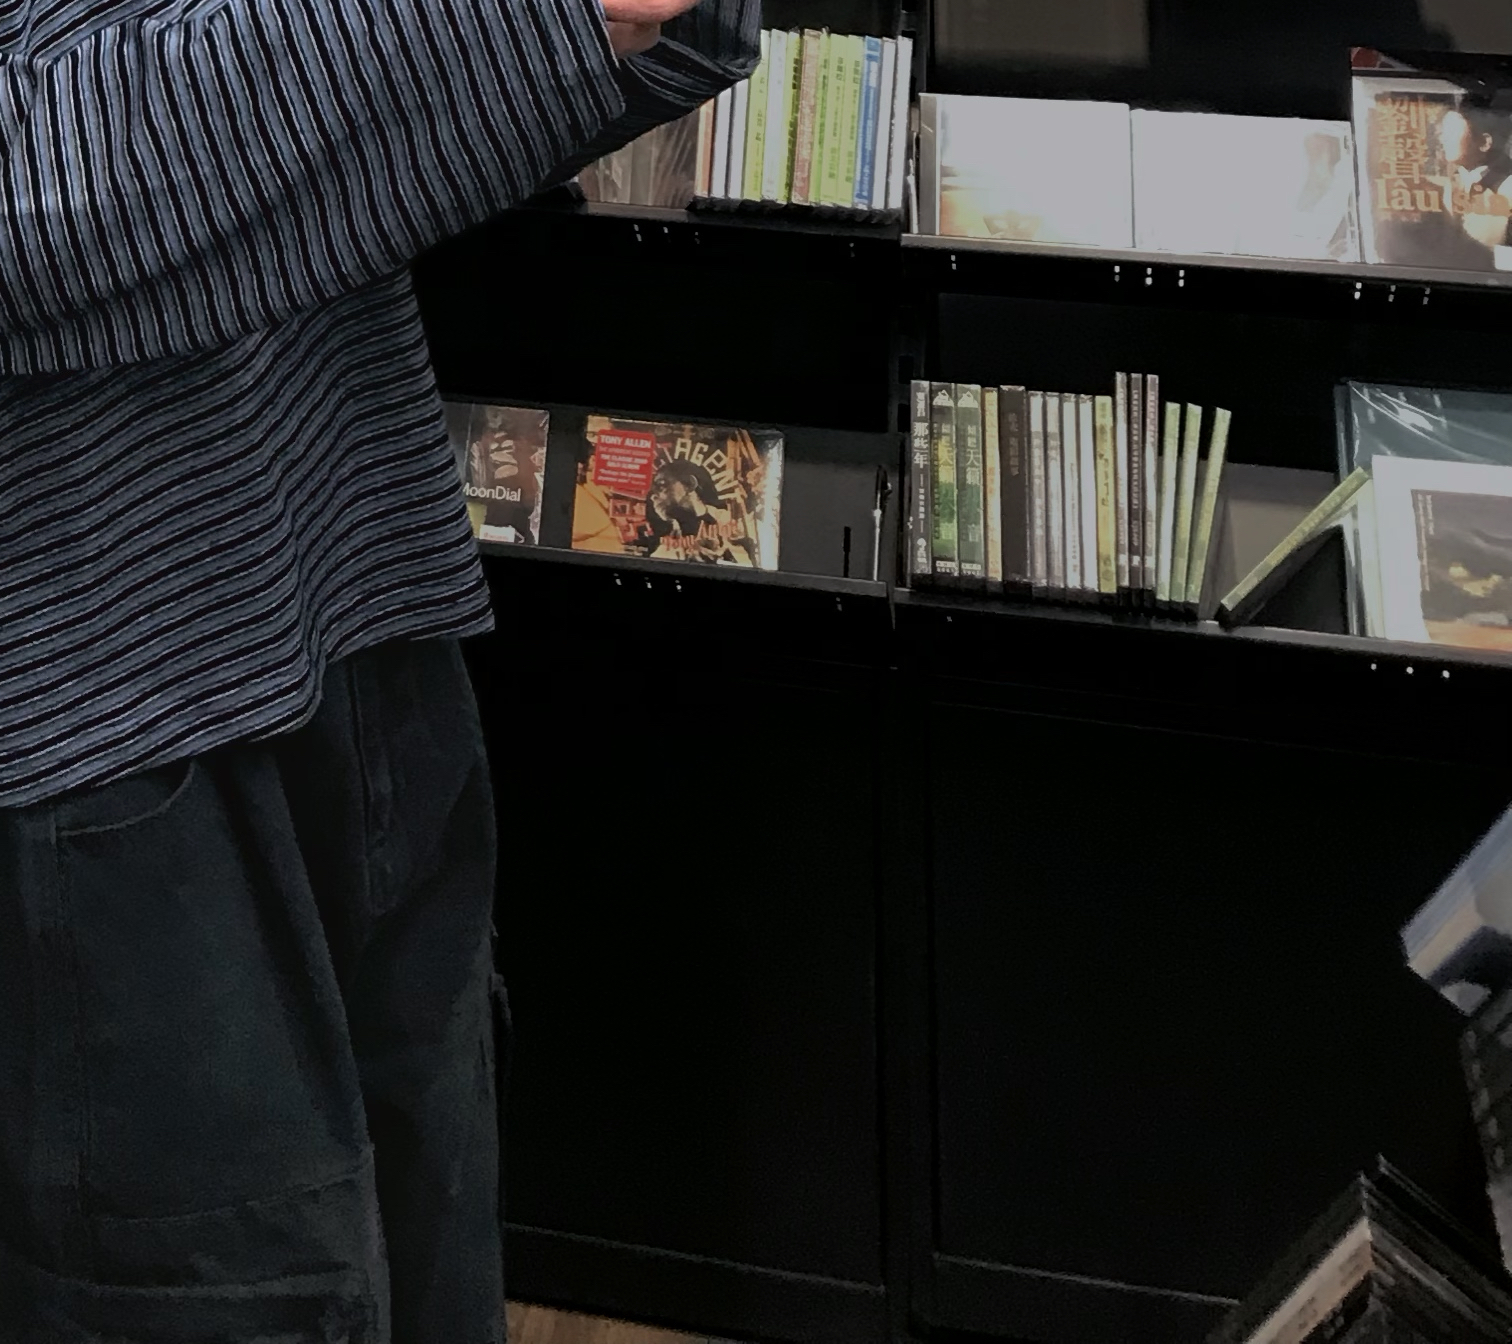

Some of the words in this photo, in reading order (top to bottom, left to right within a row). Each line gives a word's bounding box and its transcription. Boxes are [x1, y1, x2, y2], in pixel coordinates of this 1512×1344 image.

[1375, 178, 1443, 213] lâu
[600, 434, 623, 445] TONY
[624, 437, 651, 448] ALLEN
